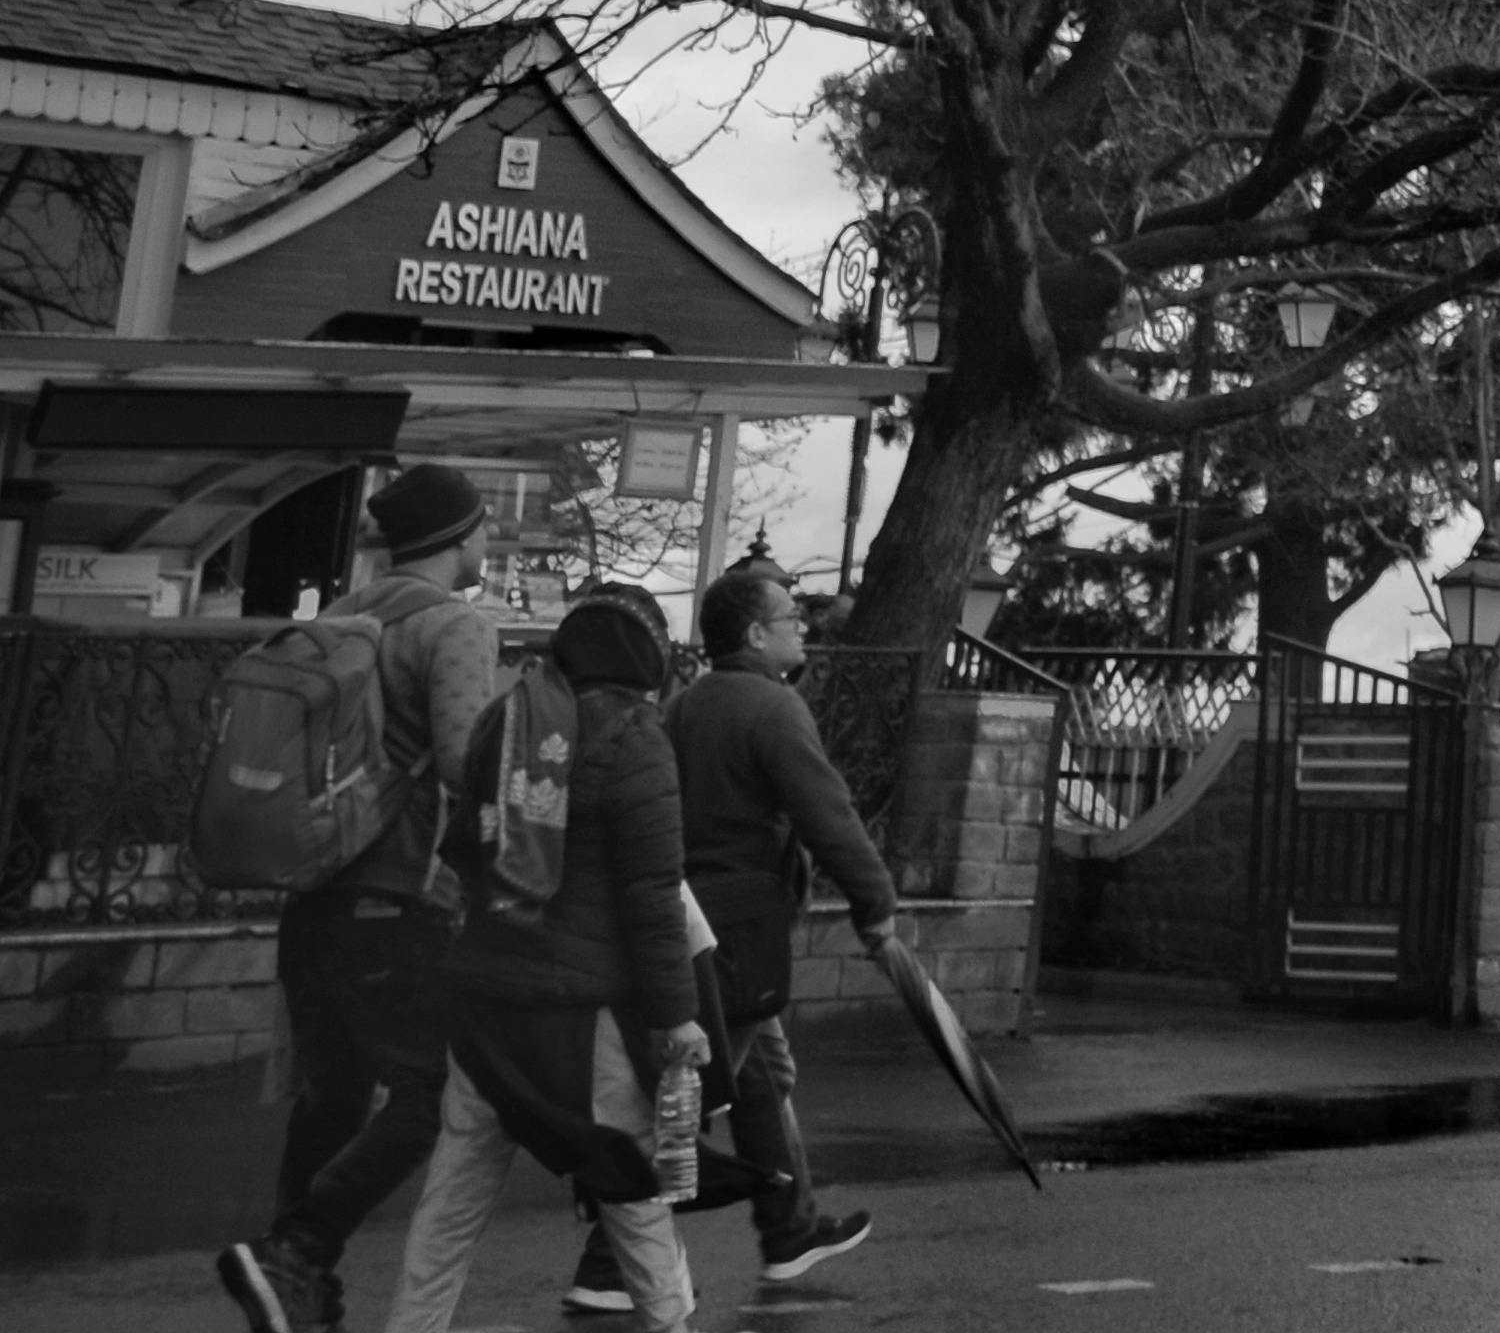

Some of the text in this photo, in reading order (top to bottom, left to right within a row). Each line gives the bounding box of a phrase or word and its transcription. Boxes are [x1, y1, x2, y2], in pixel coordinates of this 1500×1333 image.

[426, 201, 588, 260] ASHIANA
[395, 258, 609, 316] RESTAURANT
[37, 556, 99, 580] SILK
